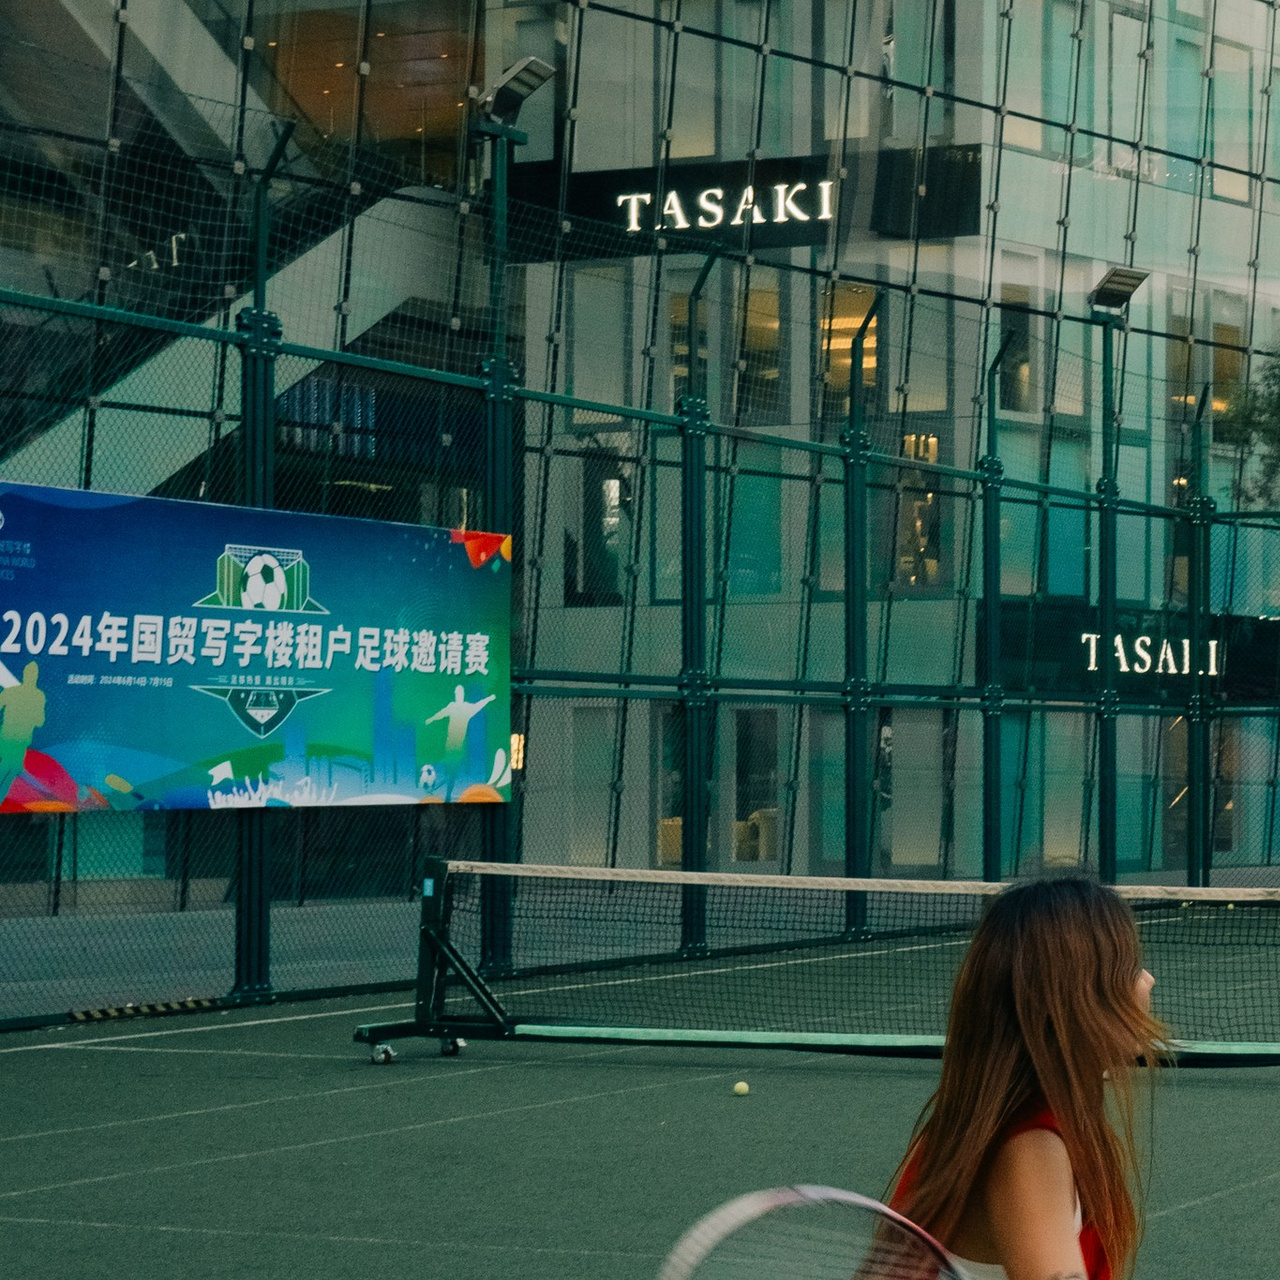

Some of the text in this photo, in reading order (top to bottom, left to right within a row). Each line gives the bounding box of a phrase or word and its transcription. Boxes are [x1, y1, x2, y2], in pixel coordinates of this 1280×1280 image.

[616, 180, 834, 232] TASAKI
[1, 609, 490, 676] 2024年国贸写字楼租户足球邀请赛
